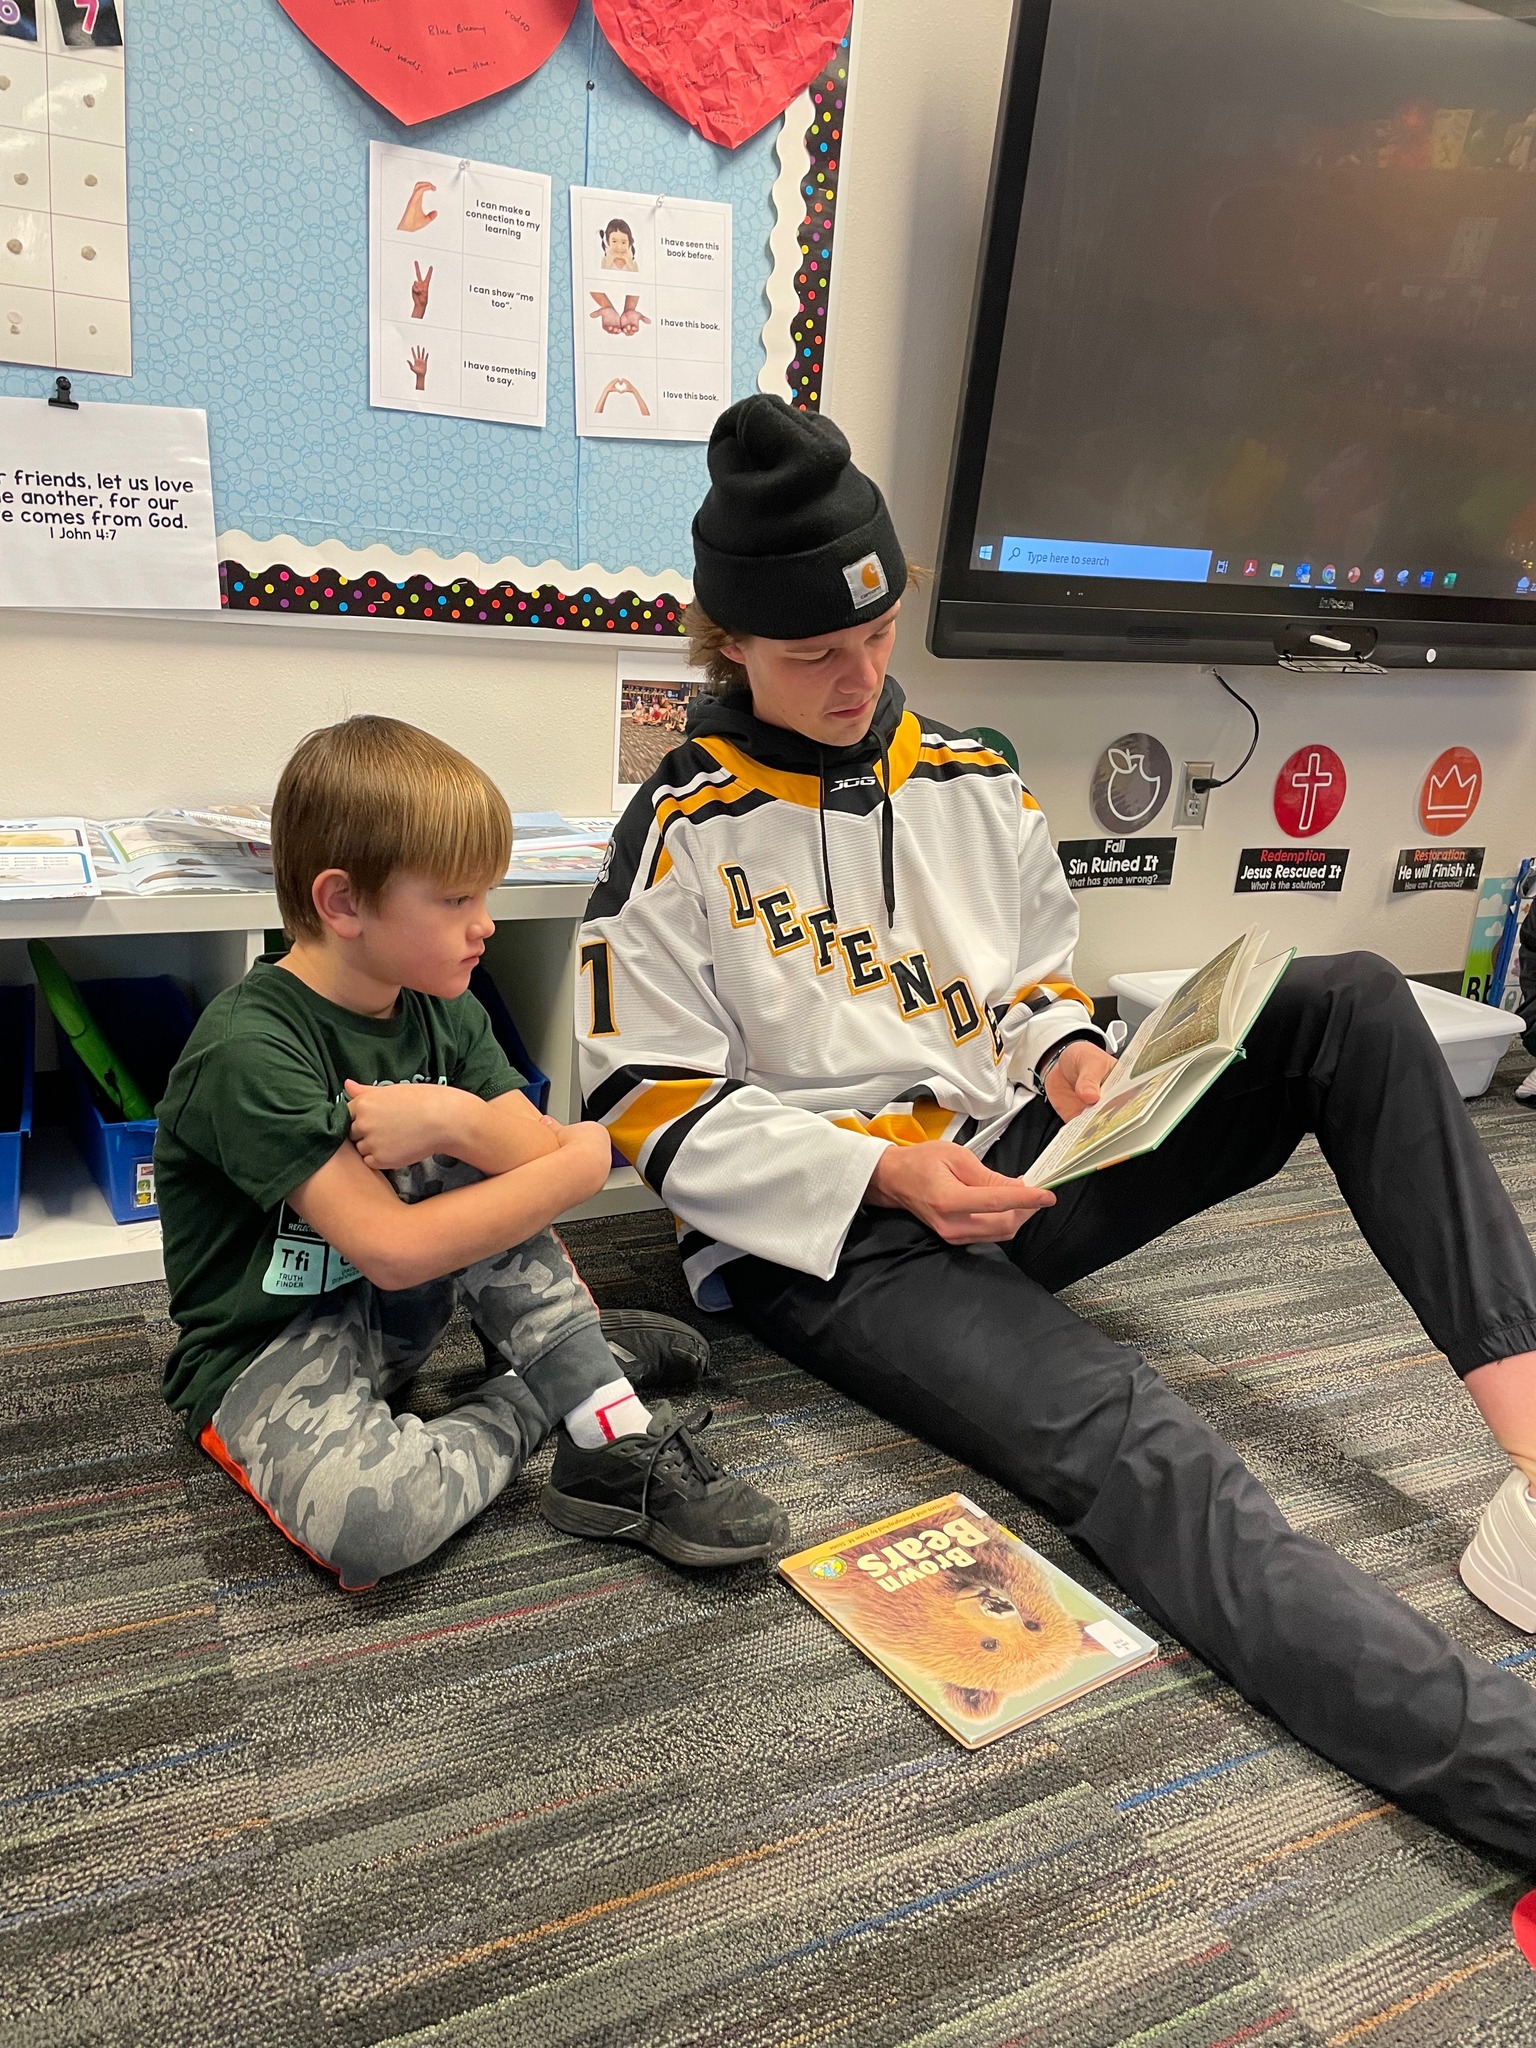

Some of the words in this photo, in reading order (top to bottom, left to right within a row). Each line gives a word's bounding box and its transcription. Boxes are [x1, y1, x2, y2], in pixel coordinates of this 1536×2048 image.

[428, 25, 452, 36] Blue
[480, 201, 497, 210] can
[499, 205, 524, 215] make
[465, 210, 515, 226] connection
[516, 219, 525, 227] to
[526, 222, 541, 232] my
[485, 224, 521, 240] learning
[665, 238, 684, 247] have
[685, 241, 704, 249] seen
[705, 242, 719, 251] this
[667, 249, 686, 258] book
[687, 251, 714, 260] before.
[473, 286, 490, 295] can
[491, 289, 515, 298] show
[664, 319, 684, 327] have
[685, 320, 699, 329] this
[700, 322, 720, 330] book.
[468, 361, 490, 371] have
[491, 366, 537, 380] something
[486, 375, 495, 383] to
[497, 377, 515, 387] say.
[667, 391, 683, 399] love
[684, 392, 698, 400] this
[699, 393, 719, 401] book.
[14, 470, 91, 490] friends,
[97, 473, 122, 490] let
[128, 478, 149, 492] us
[155, 476, 194, 493] love
[21, 490, 103, 509] another,
[109, 493, 140, 509] for
[148, 497, 179, 511] our
[21, 511, 85, 525] comes
[92, 511, 142, 527] from
[149, 512, 188, 529] God.
[59, 527, 91, 540] John
[96, 529, 117, 541] 4:7
[1027, 551, 1048, 565] Type
[1050, 552, 1069, 564] here
[1071, 555, 1080, 565] to
[1082, 555, 1110, 567] search
[1104, 839, 1126, 854] Fall
[1260, 849, 1326, 864] Redemption
[1414, 849, 1466, 862] Restoration
[1068, 857, 1088, 875] Sin
[1091, 855, 1141, 874] Ruined
[1143, 855, 1159, 872] It
[1240, 865, 1273, 880] Jesus
[1274, 864, 1327, 879] Rescued
[1328, 864, 1342, 879] It
[1398, 865, 1412, 880] He
[1414, 863, 1432, 879] will
[1432, 863, 1463, 878] finish
[1465, 863, 1476, 877] it.
[1067, 877, 1086, 888] What
[1086, 876, 1101, 887] has
[1103, 876, 1123, 888] gone
[1126, 874, 1158, 886] wrong?
[1250, 881, 1269, 890] What
[1270, 881, 1277, 890] is
[1278, 880, 1290, 890] the
[1291, 880, 1326, 890] solution?
[1404, 881, 1417, 891] How
[1417, 881, 1428, 889] can
[1433, 880, 1464, 890] respond?
[275, 1279, 304, 1289] FINDER
[278, 1272, 304, 1282] TRUTH
[857, 1517, 990, 1578] Bears
[876, 1546, 977, 1593] Brown
